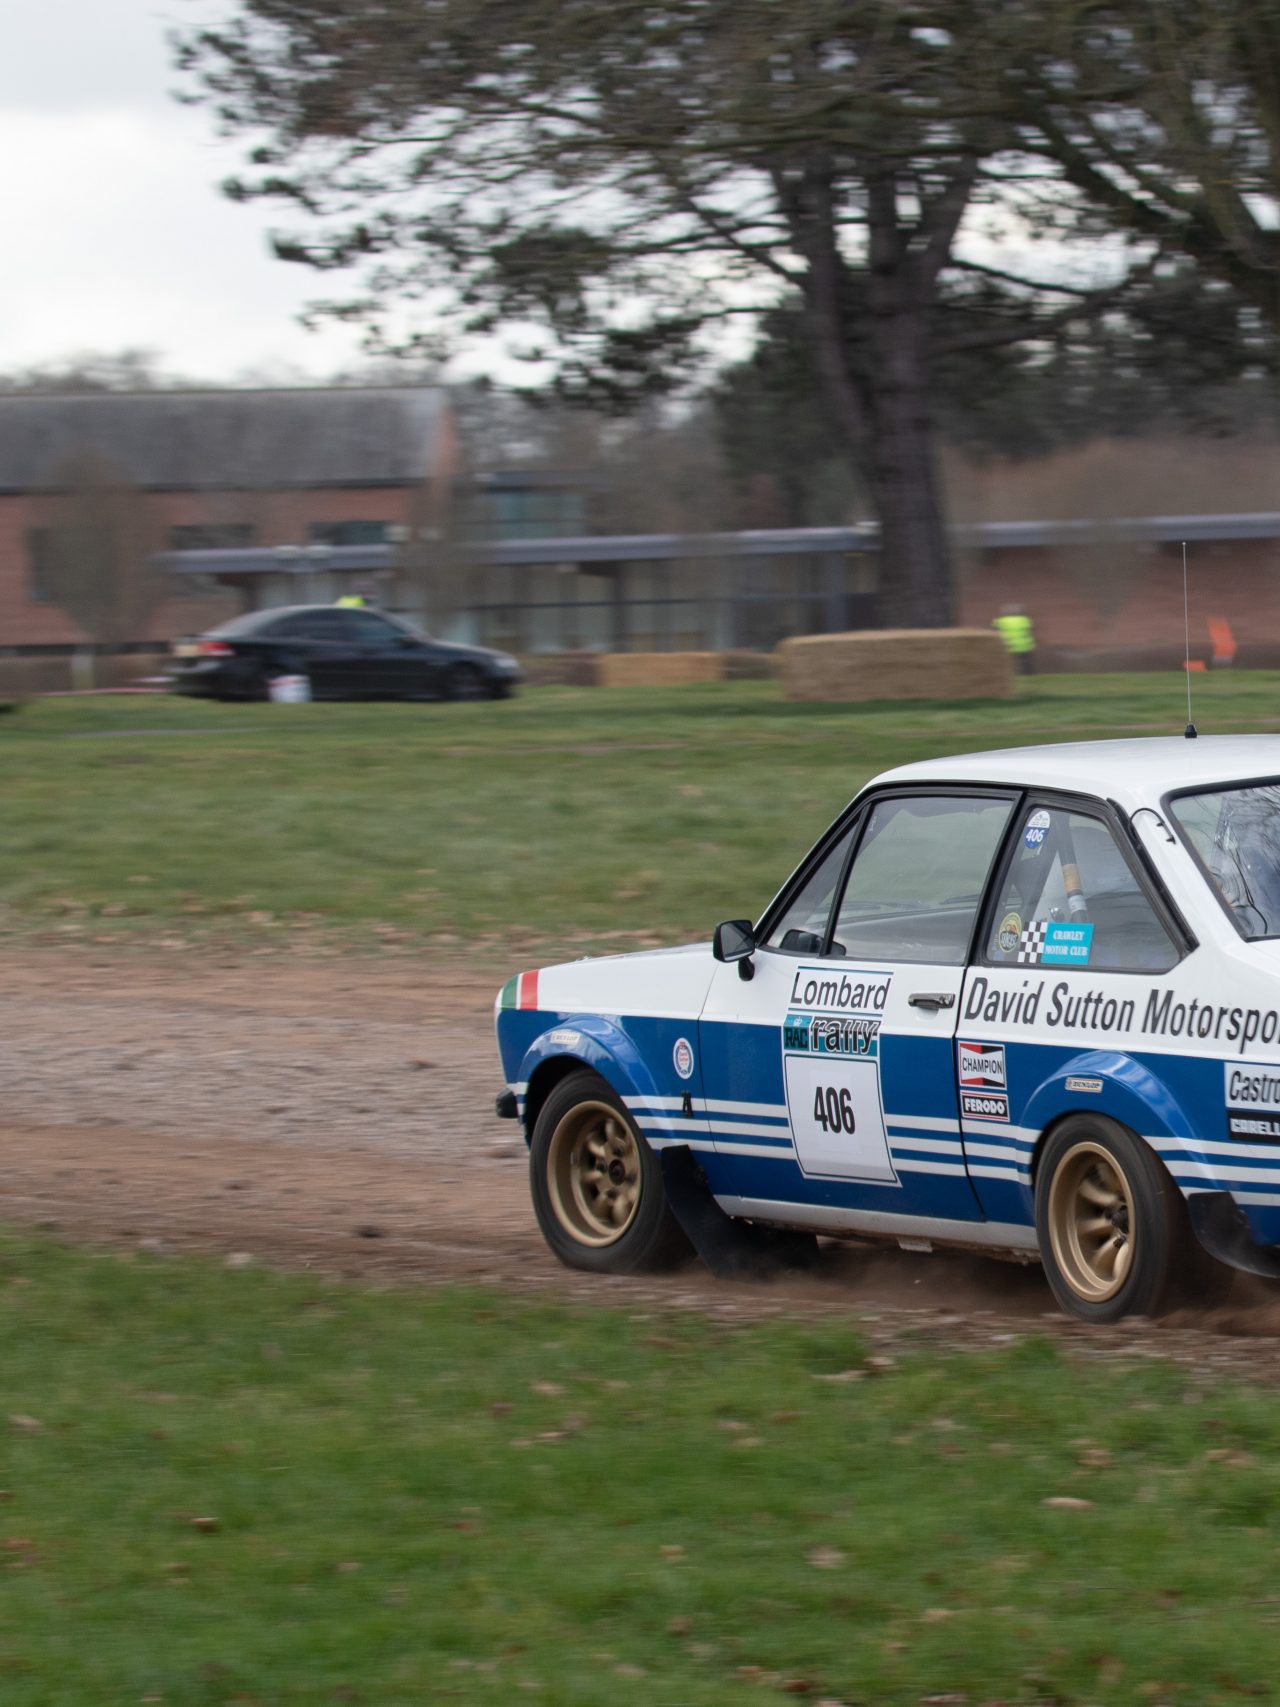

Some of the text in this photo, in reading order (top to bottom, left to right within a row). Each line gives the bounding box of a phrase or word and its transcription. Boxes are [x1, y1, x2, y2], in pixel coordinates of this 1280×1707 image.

[1025, 828, 1045, 843] 406
[1053, 930, 1085, 941] CRAWLEY
[1045, 945, 1088, 956] MOTOR CLUB
[790, 972, 892, 1010] Lombard
[964, 977, 1044, 1025] David
[1046, 982, 1135, 1032] Sutton
[785, 1019, 881, 1055] RAC rally
[962, 1057, 1003, 1075] CHAMPION
[814, 1086, 855, 1135] 406
[964, 1097, 1006, 1115] FERODO
